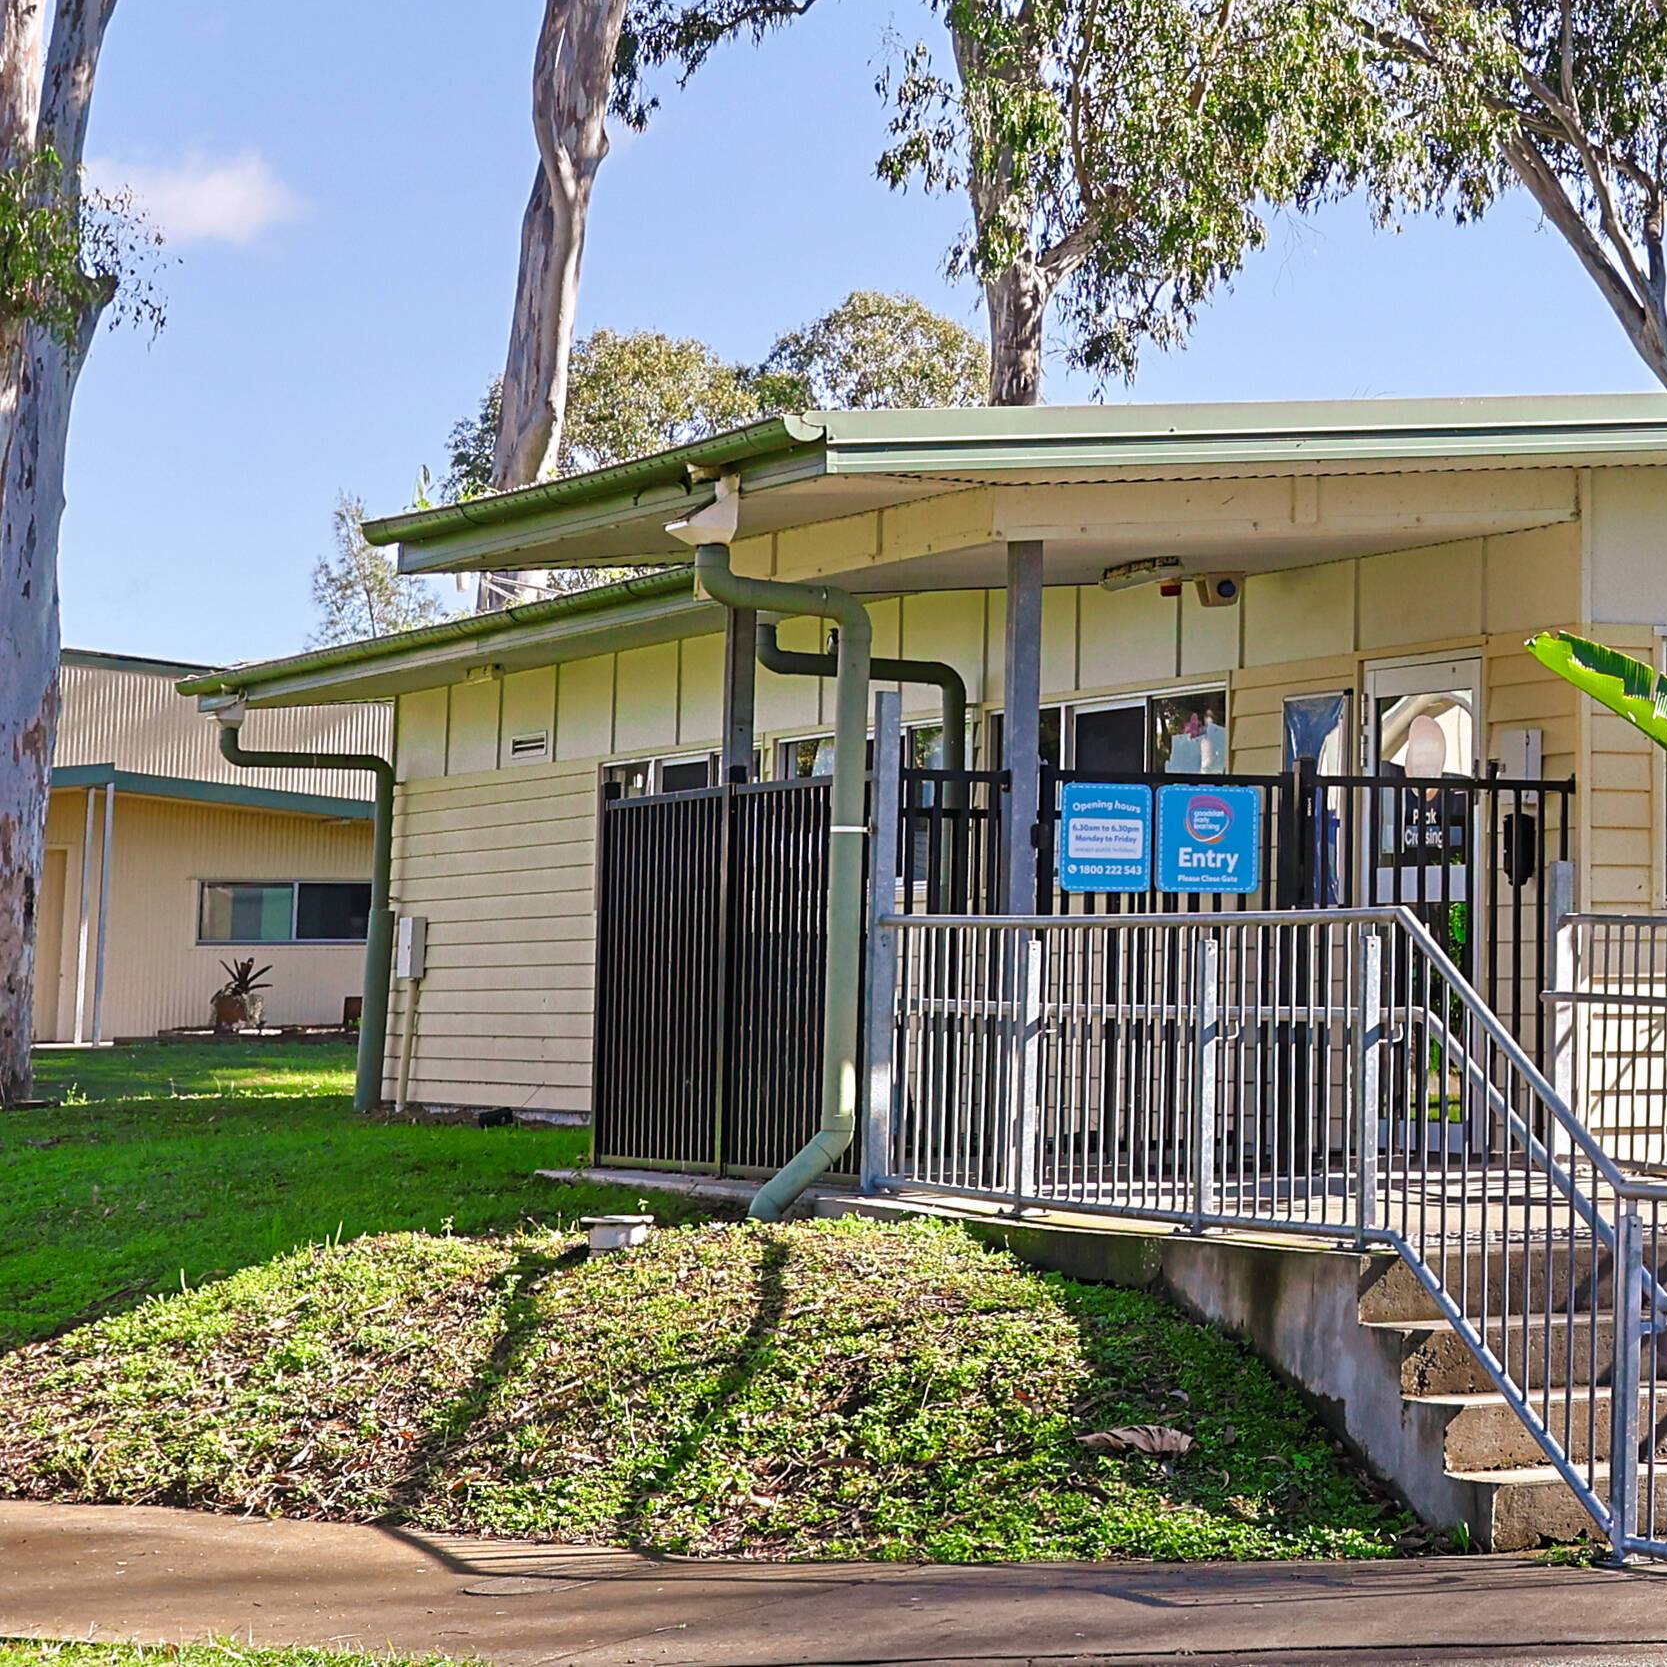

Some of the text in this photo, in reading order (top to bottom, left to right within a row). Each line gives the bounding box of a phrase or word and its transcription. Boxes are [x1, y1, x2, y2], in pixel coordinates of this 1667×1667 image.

[1072, 800, 1141, 814] Opening hours
[1412, 807, 1437, 825] Pak
[1101, 824, 1110, 832] to
[1075, 834, 1138, 844] Monday to Friday
[1404, 828, 1443, 849] Crsing
[1178, 846, 1239, 873] Entry
[1079, 864, 1142, 875] 1800 222 543
[1177, 874, 1200, 883] Please
[1221, 875, 1238, 883] Gate
